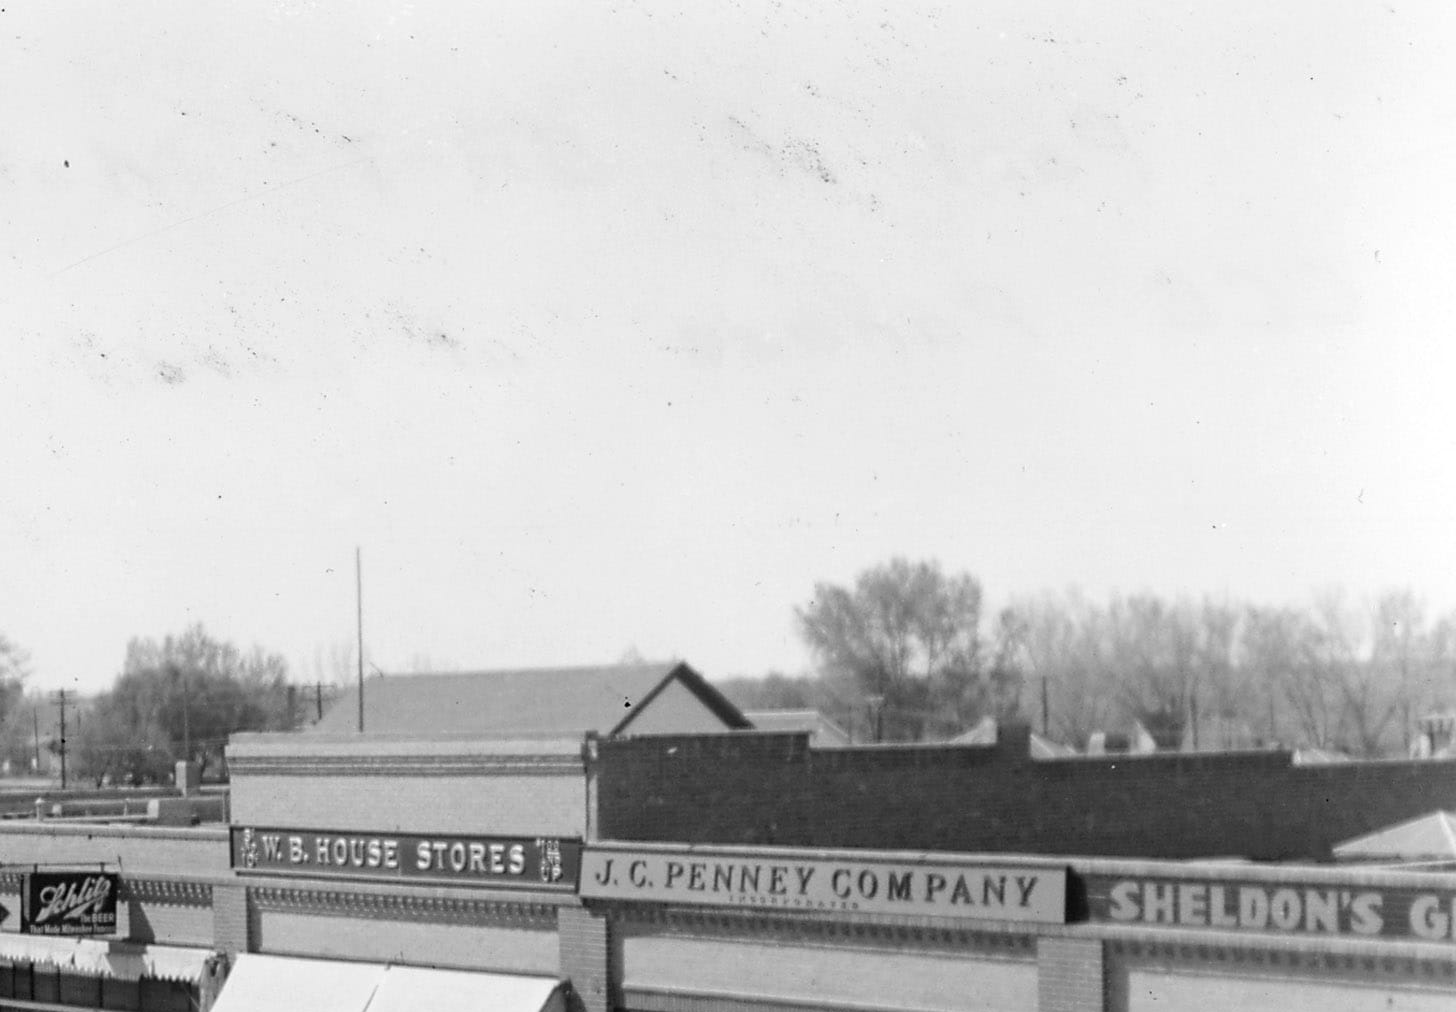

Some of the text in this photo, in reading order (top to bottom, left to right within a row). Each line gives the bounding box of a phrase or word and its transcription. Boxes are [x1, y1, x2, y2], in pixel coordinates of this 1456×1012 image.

[262, 835, 525, 874] W. B. HOUSE STORES
[35, 876, 112, 922] Schlitz
[595, 858, 1040, 908] J. C. PENNEY COMPANY
[92, 912, 115, 924] BEER
[1109, 881, 1456, 941] SHELDON'S G
